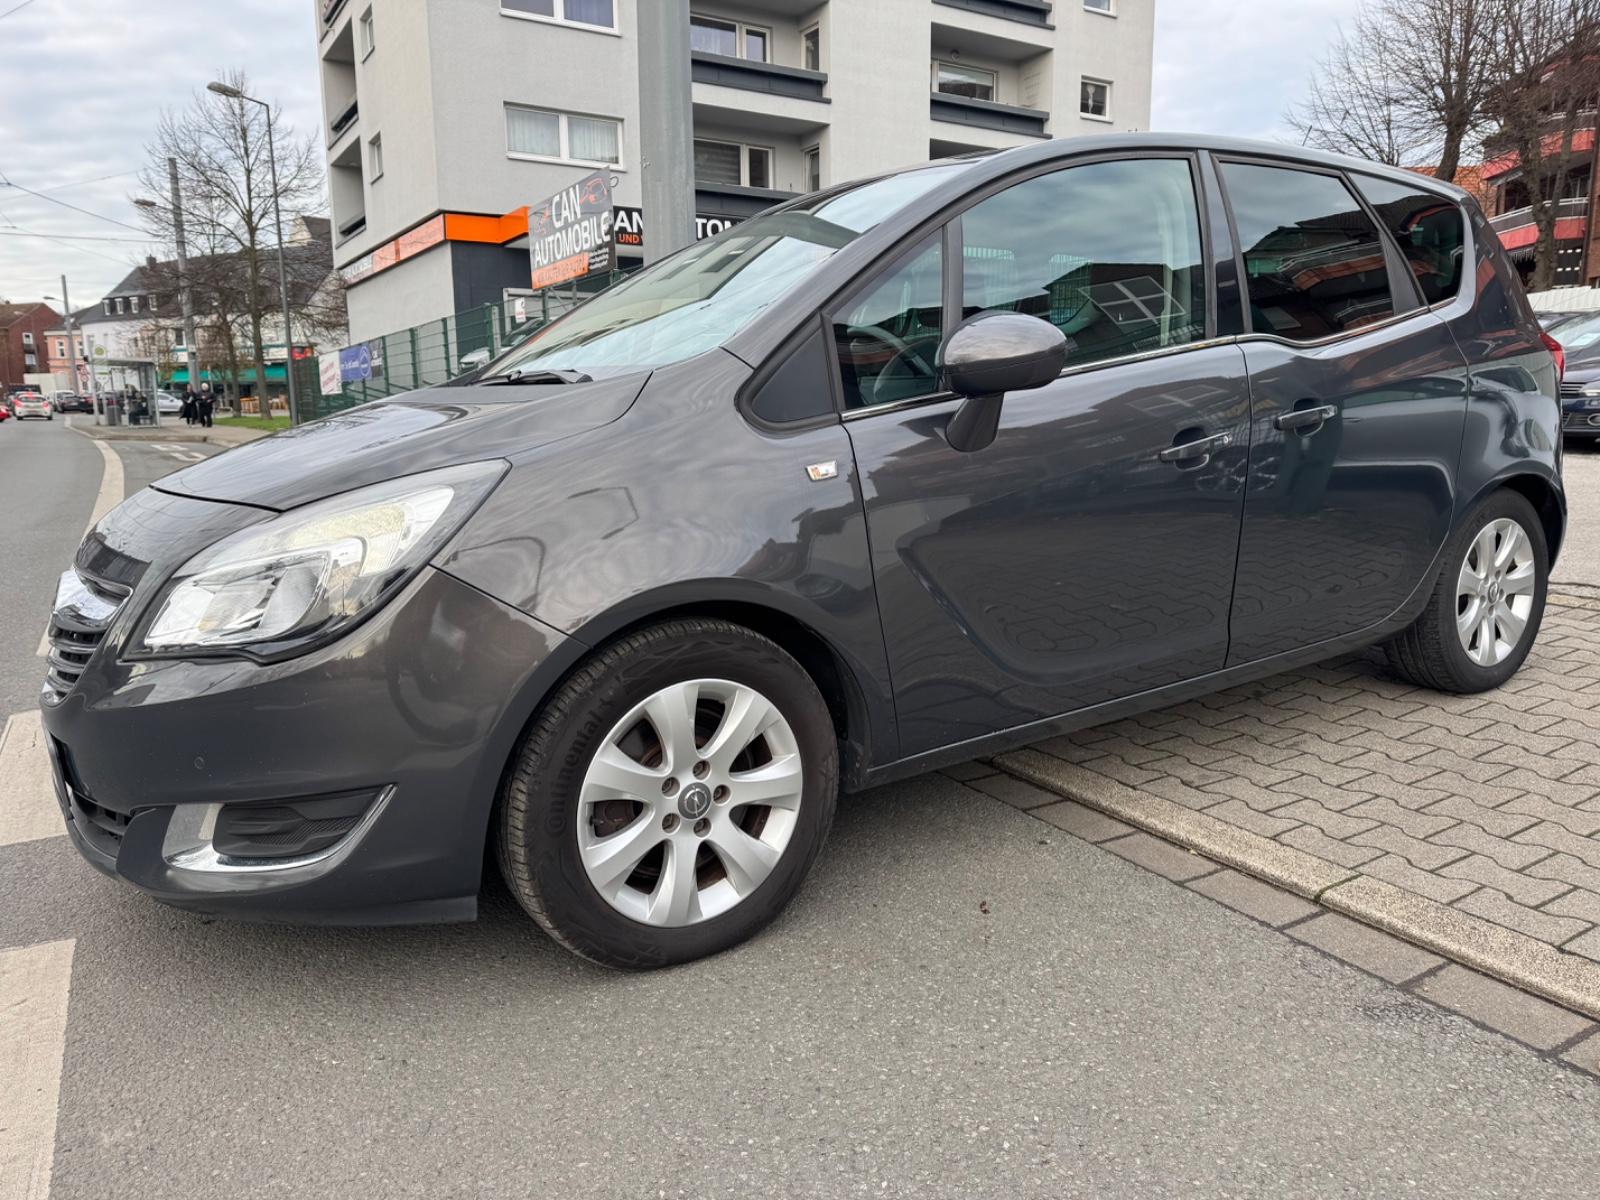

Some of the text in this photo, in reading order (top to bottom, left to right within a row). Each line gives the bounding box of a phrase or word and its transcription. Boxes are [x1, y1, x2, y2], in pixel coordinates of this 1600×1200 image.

[552, 184, 581, 229] CAN
[534, 211, 611, 269] AUTOMOBILE
[618, 233, 640, 244] UND
[546, 709, 604, 835] Continental
